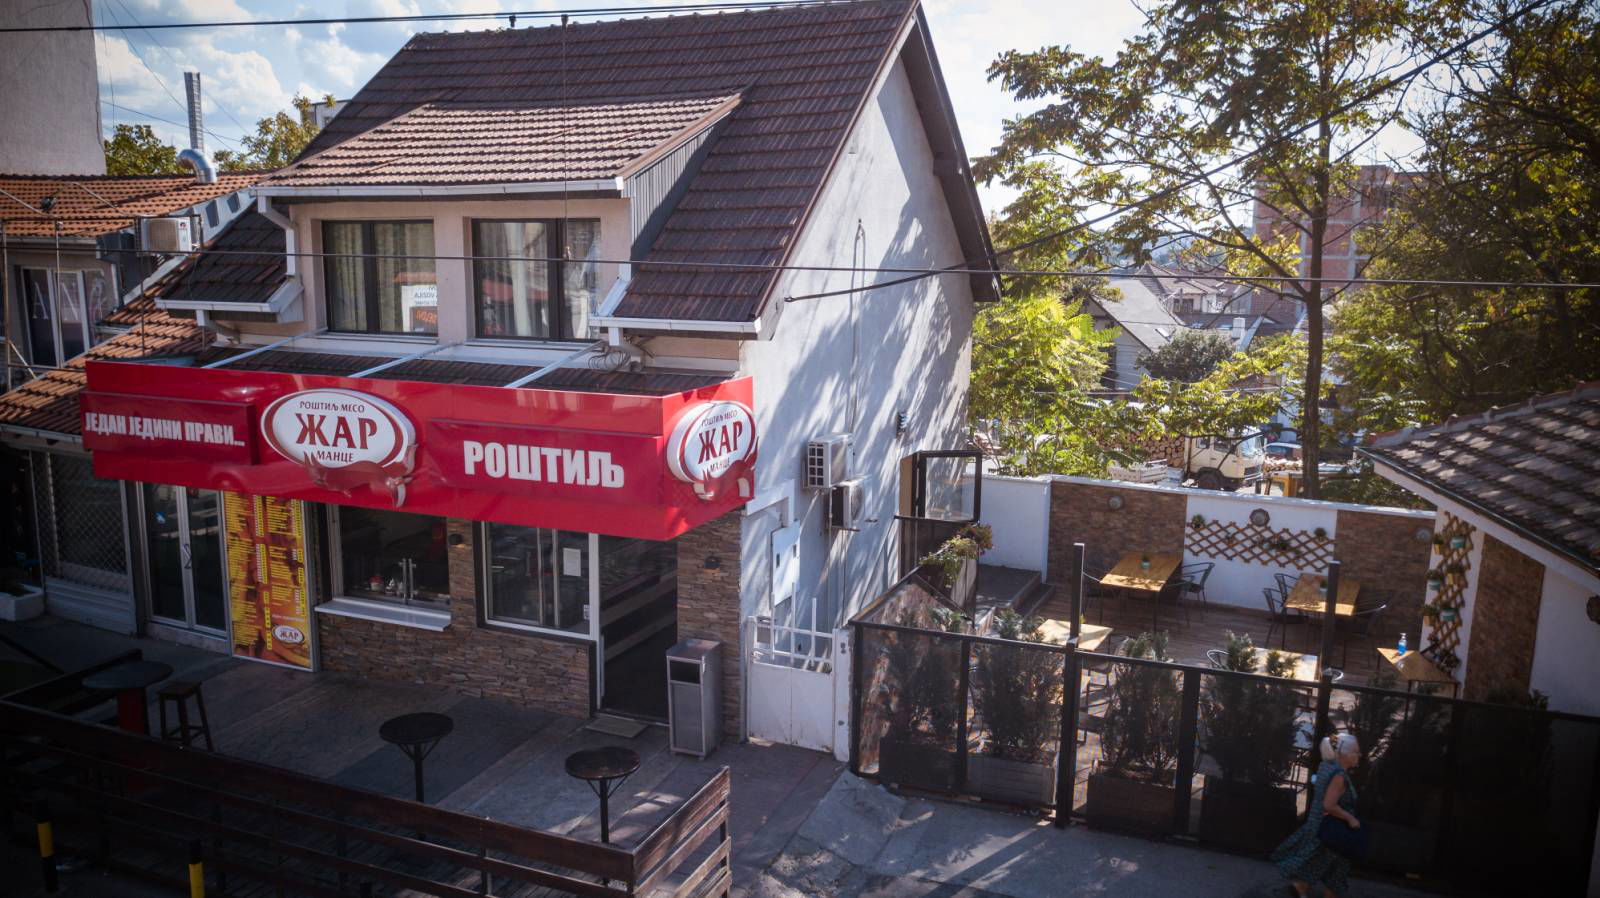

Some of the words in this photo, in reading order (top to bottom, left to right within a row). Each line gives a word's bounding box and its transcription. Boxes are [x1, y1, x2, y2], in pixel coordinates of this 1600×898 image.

[300, 400, 339, 411] РОШТИЉ
[341, 403, 365, 413] МЕСО
[85, 412, 126, 435] ЈЕДАН
[129, 416, 182, 440] ЈЕДИНИ
[295, 413, 377, 450] ЖАР
[698, 420, 742, 464] ЖАР
[315, 450, 353, 463] МАНЦЕ
[463, 440, 625, 488] РОШТИЉ
